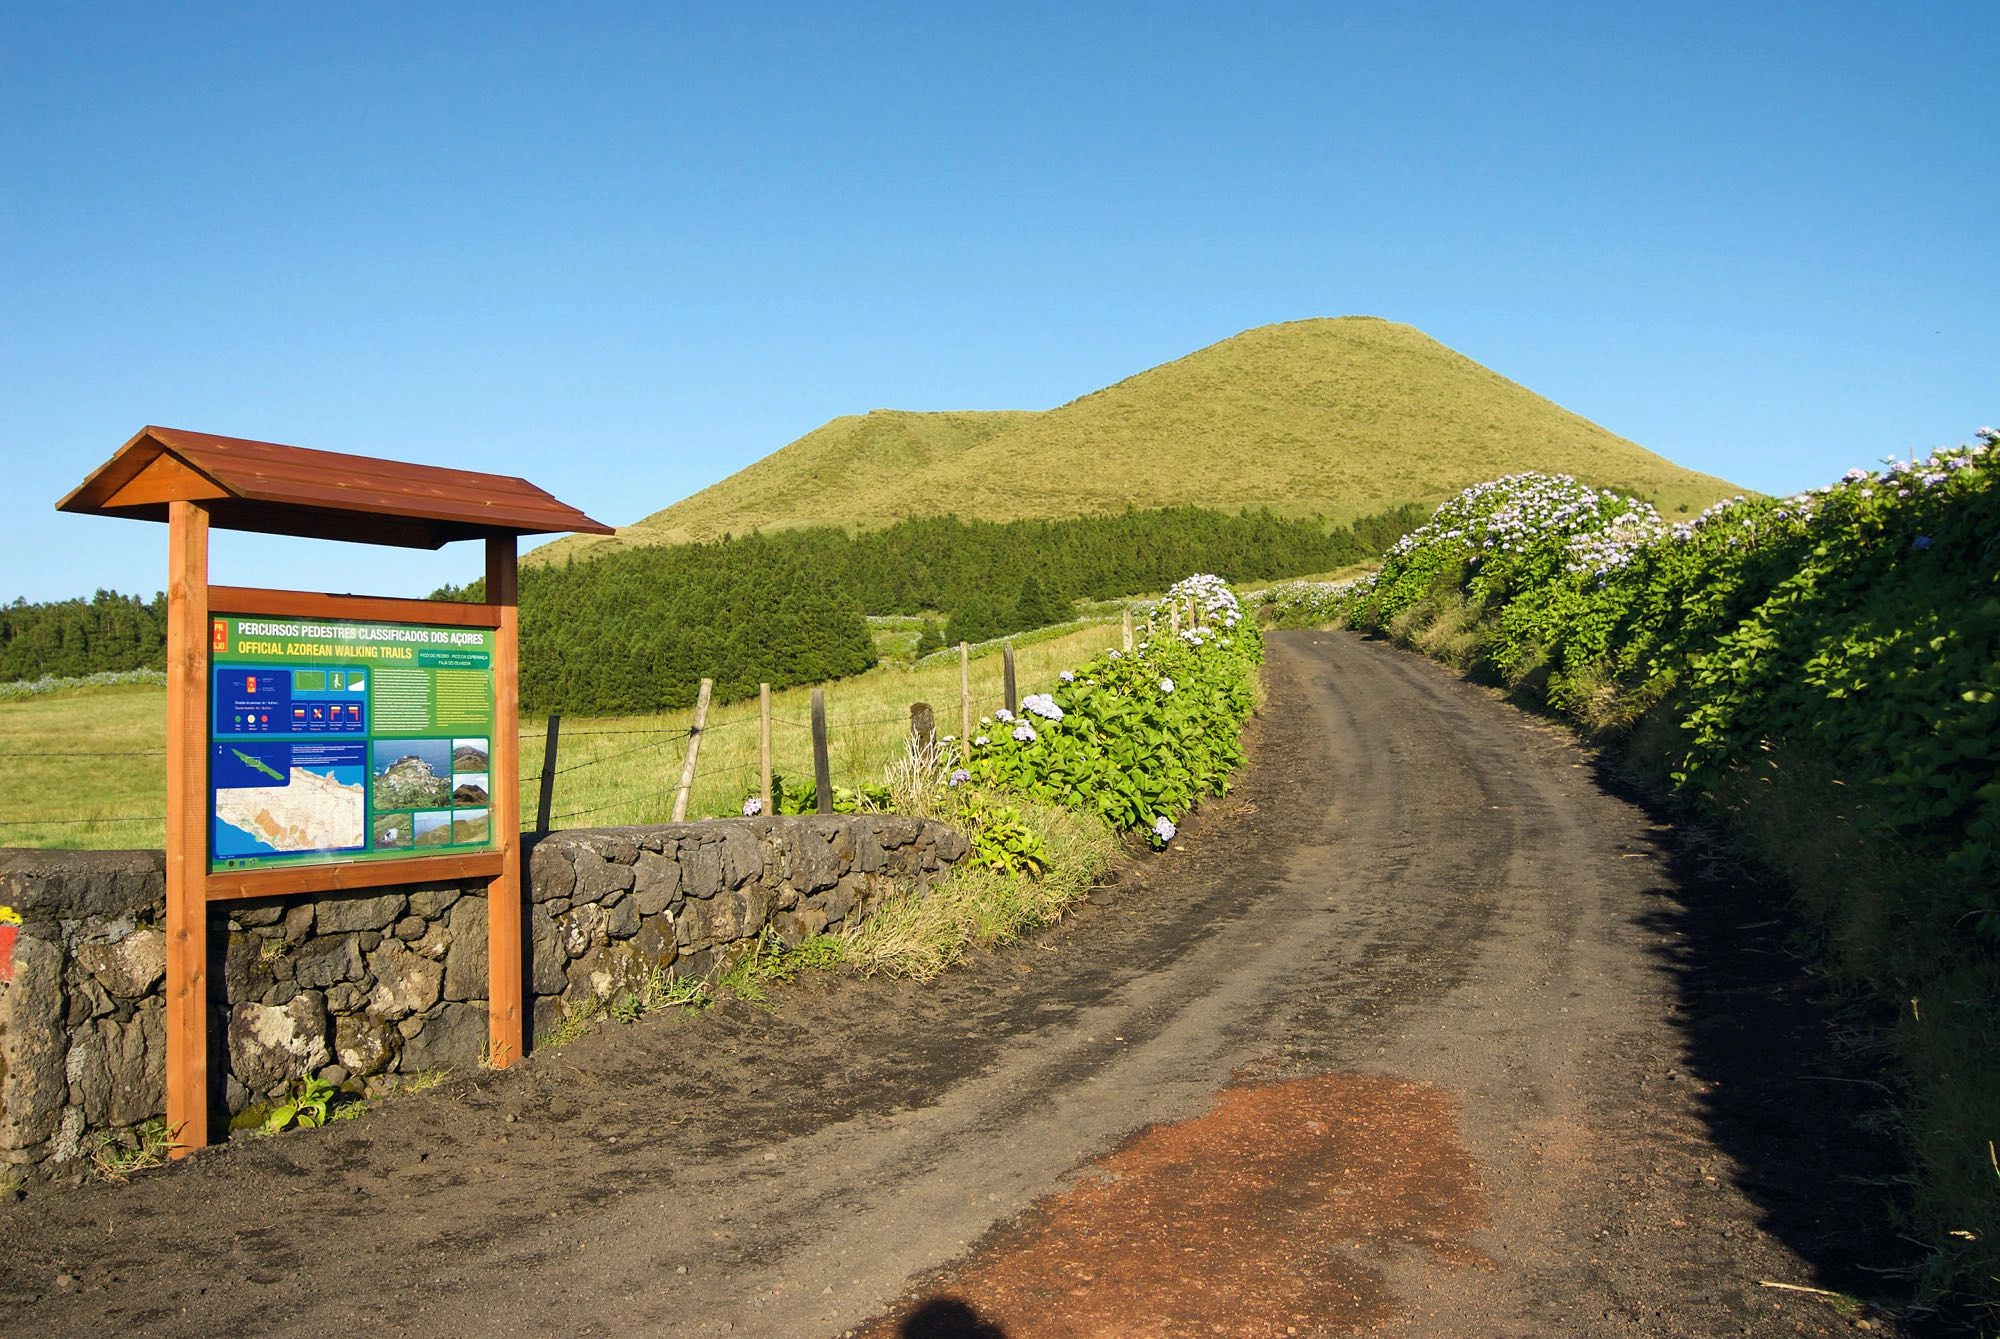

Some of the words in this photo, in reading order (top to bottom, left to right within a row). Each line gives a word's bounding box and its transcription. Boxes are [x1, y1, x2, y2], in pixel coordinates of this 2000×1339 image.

[214, 623, 223, 631] PR
[238, 622, 299, 637] PERCURSOS
[301, 625, 356, 639] PEDESTRES
[358, 628, 428, 642] CLASSIFICADOS
[431, 631, 448, 643] DOS
[450, 633, 483, 646] AÇORES
[238, 641, 284, 655] OFFICIAL
[286, 643, 332, 657] AZOREAN
[334, 645, 378, 658] WALKING
[380, 647, 412, 659] TRAILS
